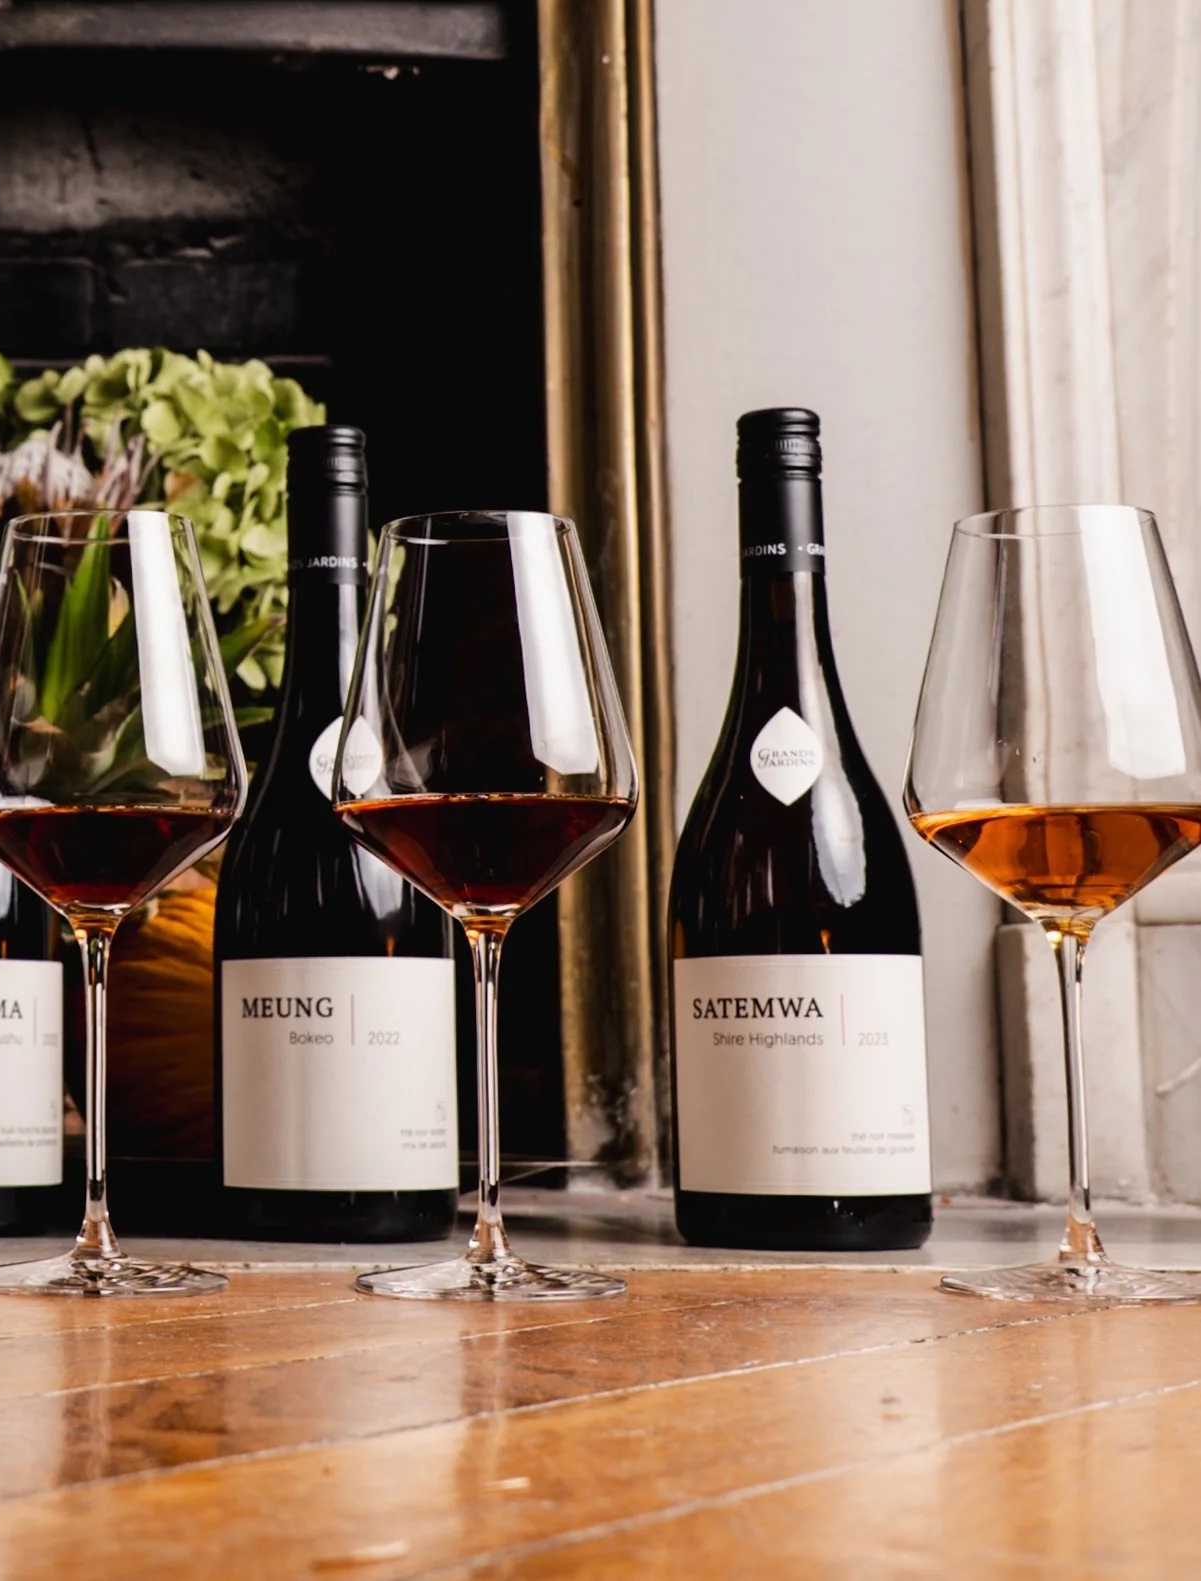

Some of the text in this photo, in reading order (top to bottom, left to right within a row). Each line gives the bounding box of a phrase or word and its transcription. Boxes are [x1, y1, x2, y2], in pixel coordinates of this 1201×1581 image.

[307, 556, 358, 569] JARDINS
[242, 997, 334, 1019] MEUNG
[693, 997, 824, 1019] SATEMWA
[289, 1031, 400, 1046] Bokeo 2022
[713, 1031, 889, 1049] Shire Highlands 2023
